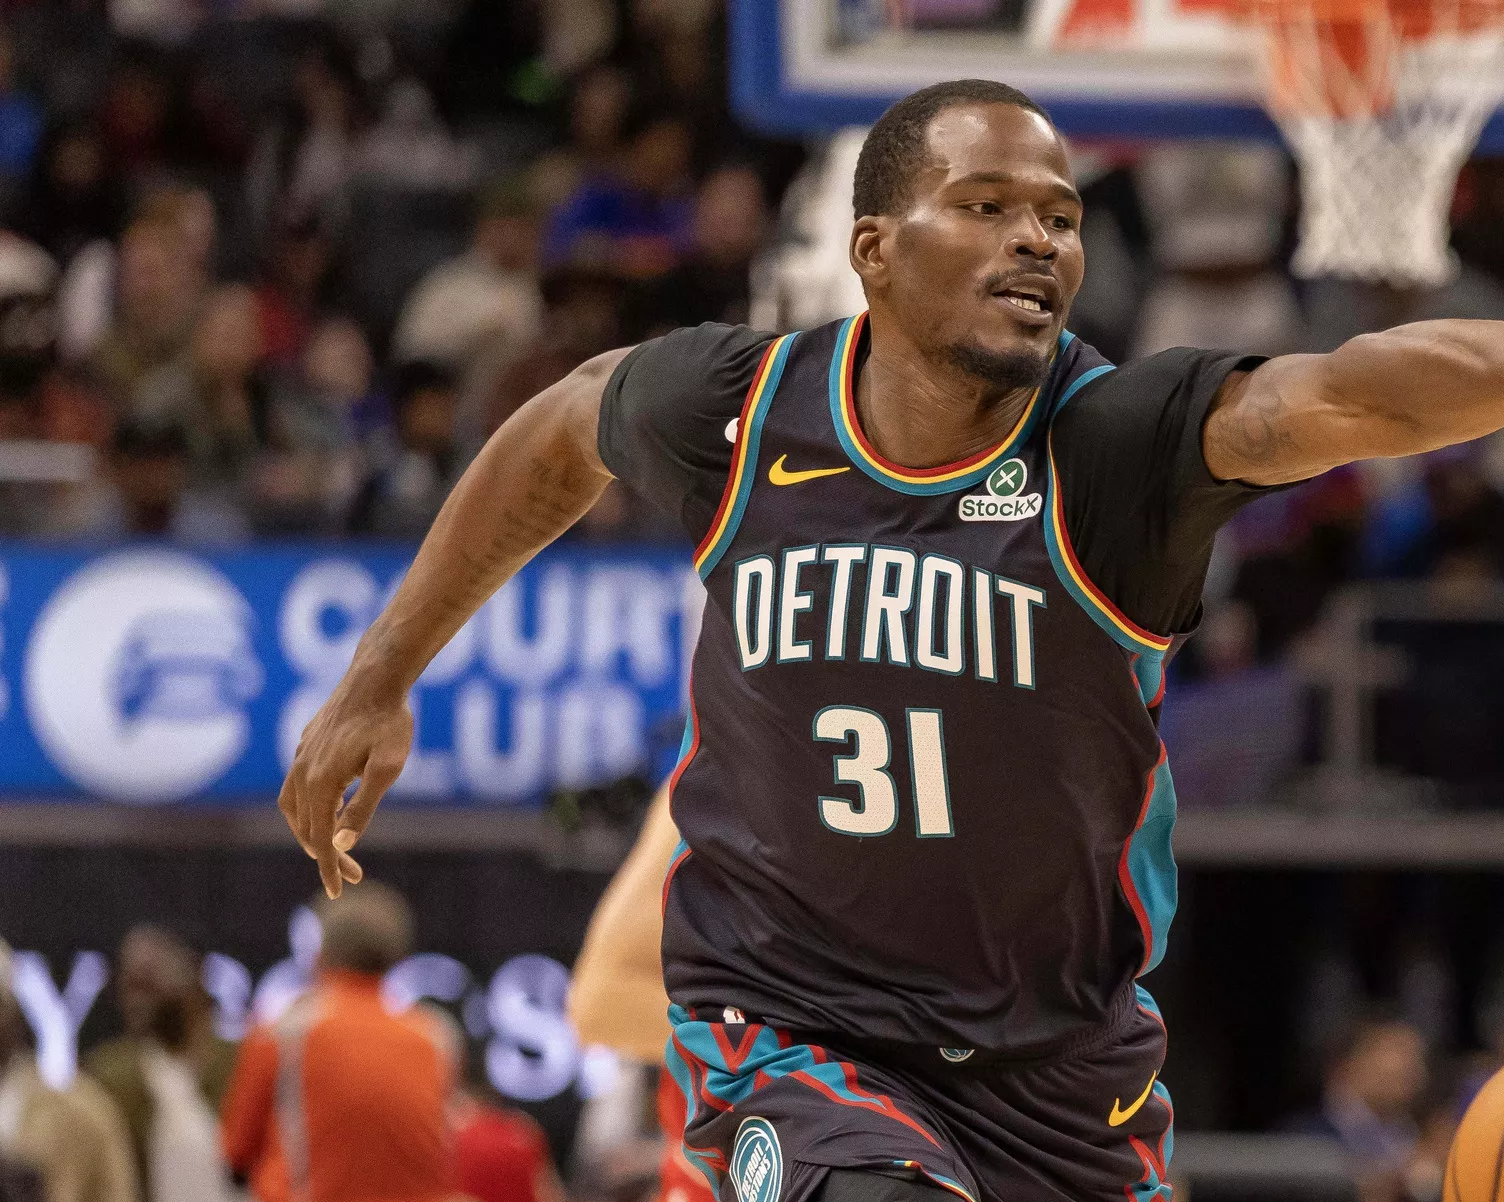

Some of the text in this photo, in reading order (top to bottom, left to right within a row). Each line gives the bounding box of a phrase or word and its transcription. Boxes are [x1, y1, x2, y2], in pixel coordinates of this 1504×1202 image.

[961, 494, 1039, 518] StockX
[732, 542, 1047, 690] DETROIT
[812, 704, 955, 839] 31
[741, 1140, 764, 1200] DETROIT
